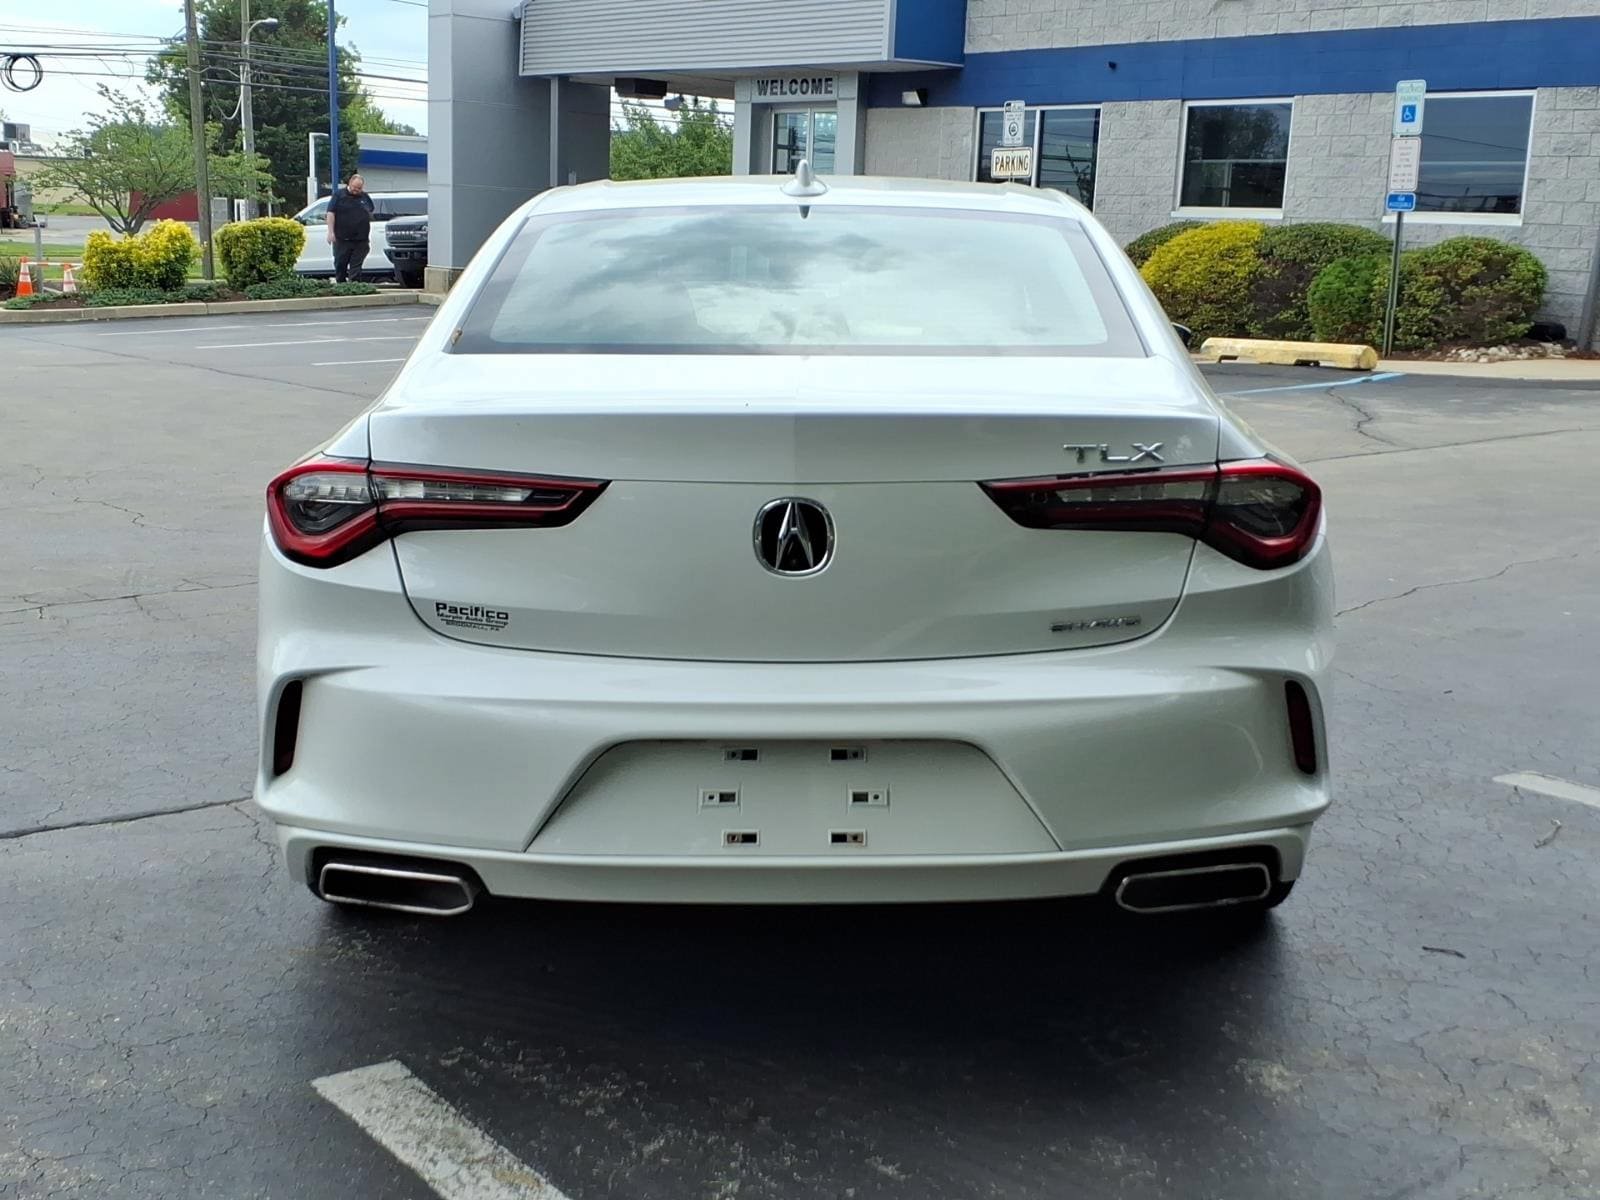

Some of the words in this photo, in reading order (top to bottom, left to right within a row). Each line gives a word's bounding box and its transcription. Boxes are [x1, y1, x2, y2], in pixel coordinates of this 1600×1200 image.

[757, 77, 834, 96] WELCOME
[995, 155, 1029, 171] PARKING
[1063, 441, 1165, 463] TLX
[435, 602, 509, 620] Pacifico
